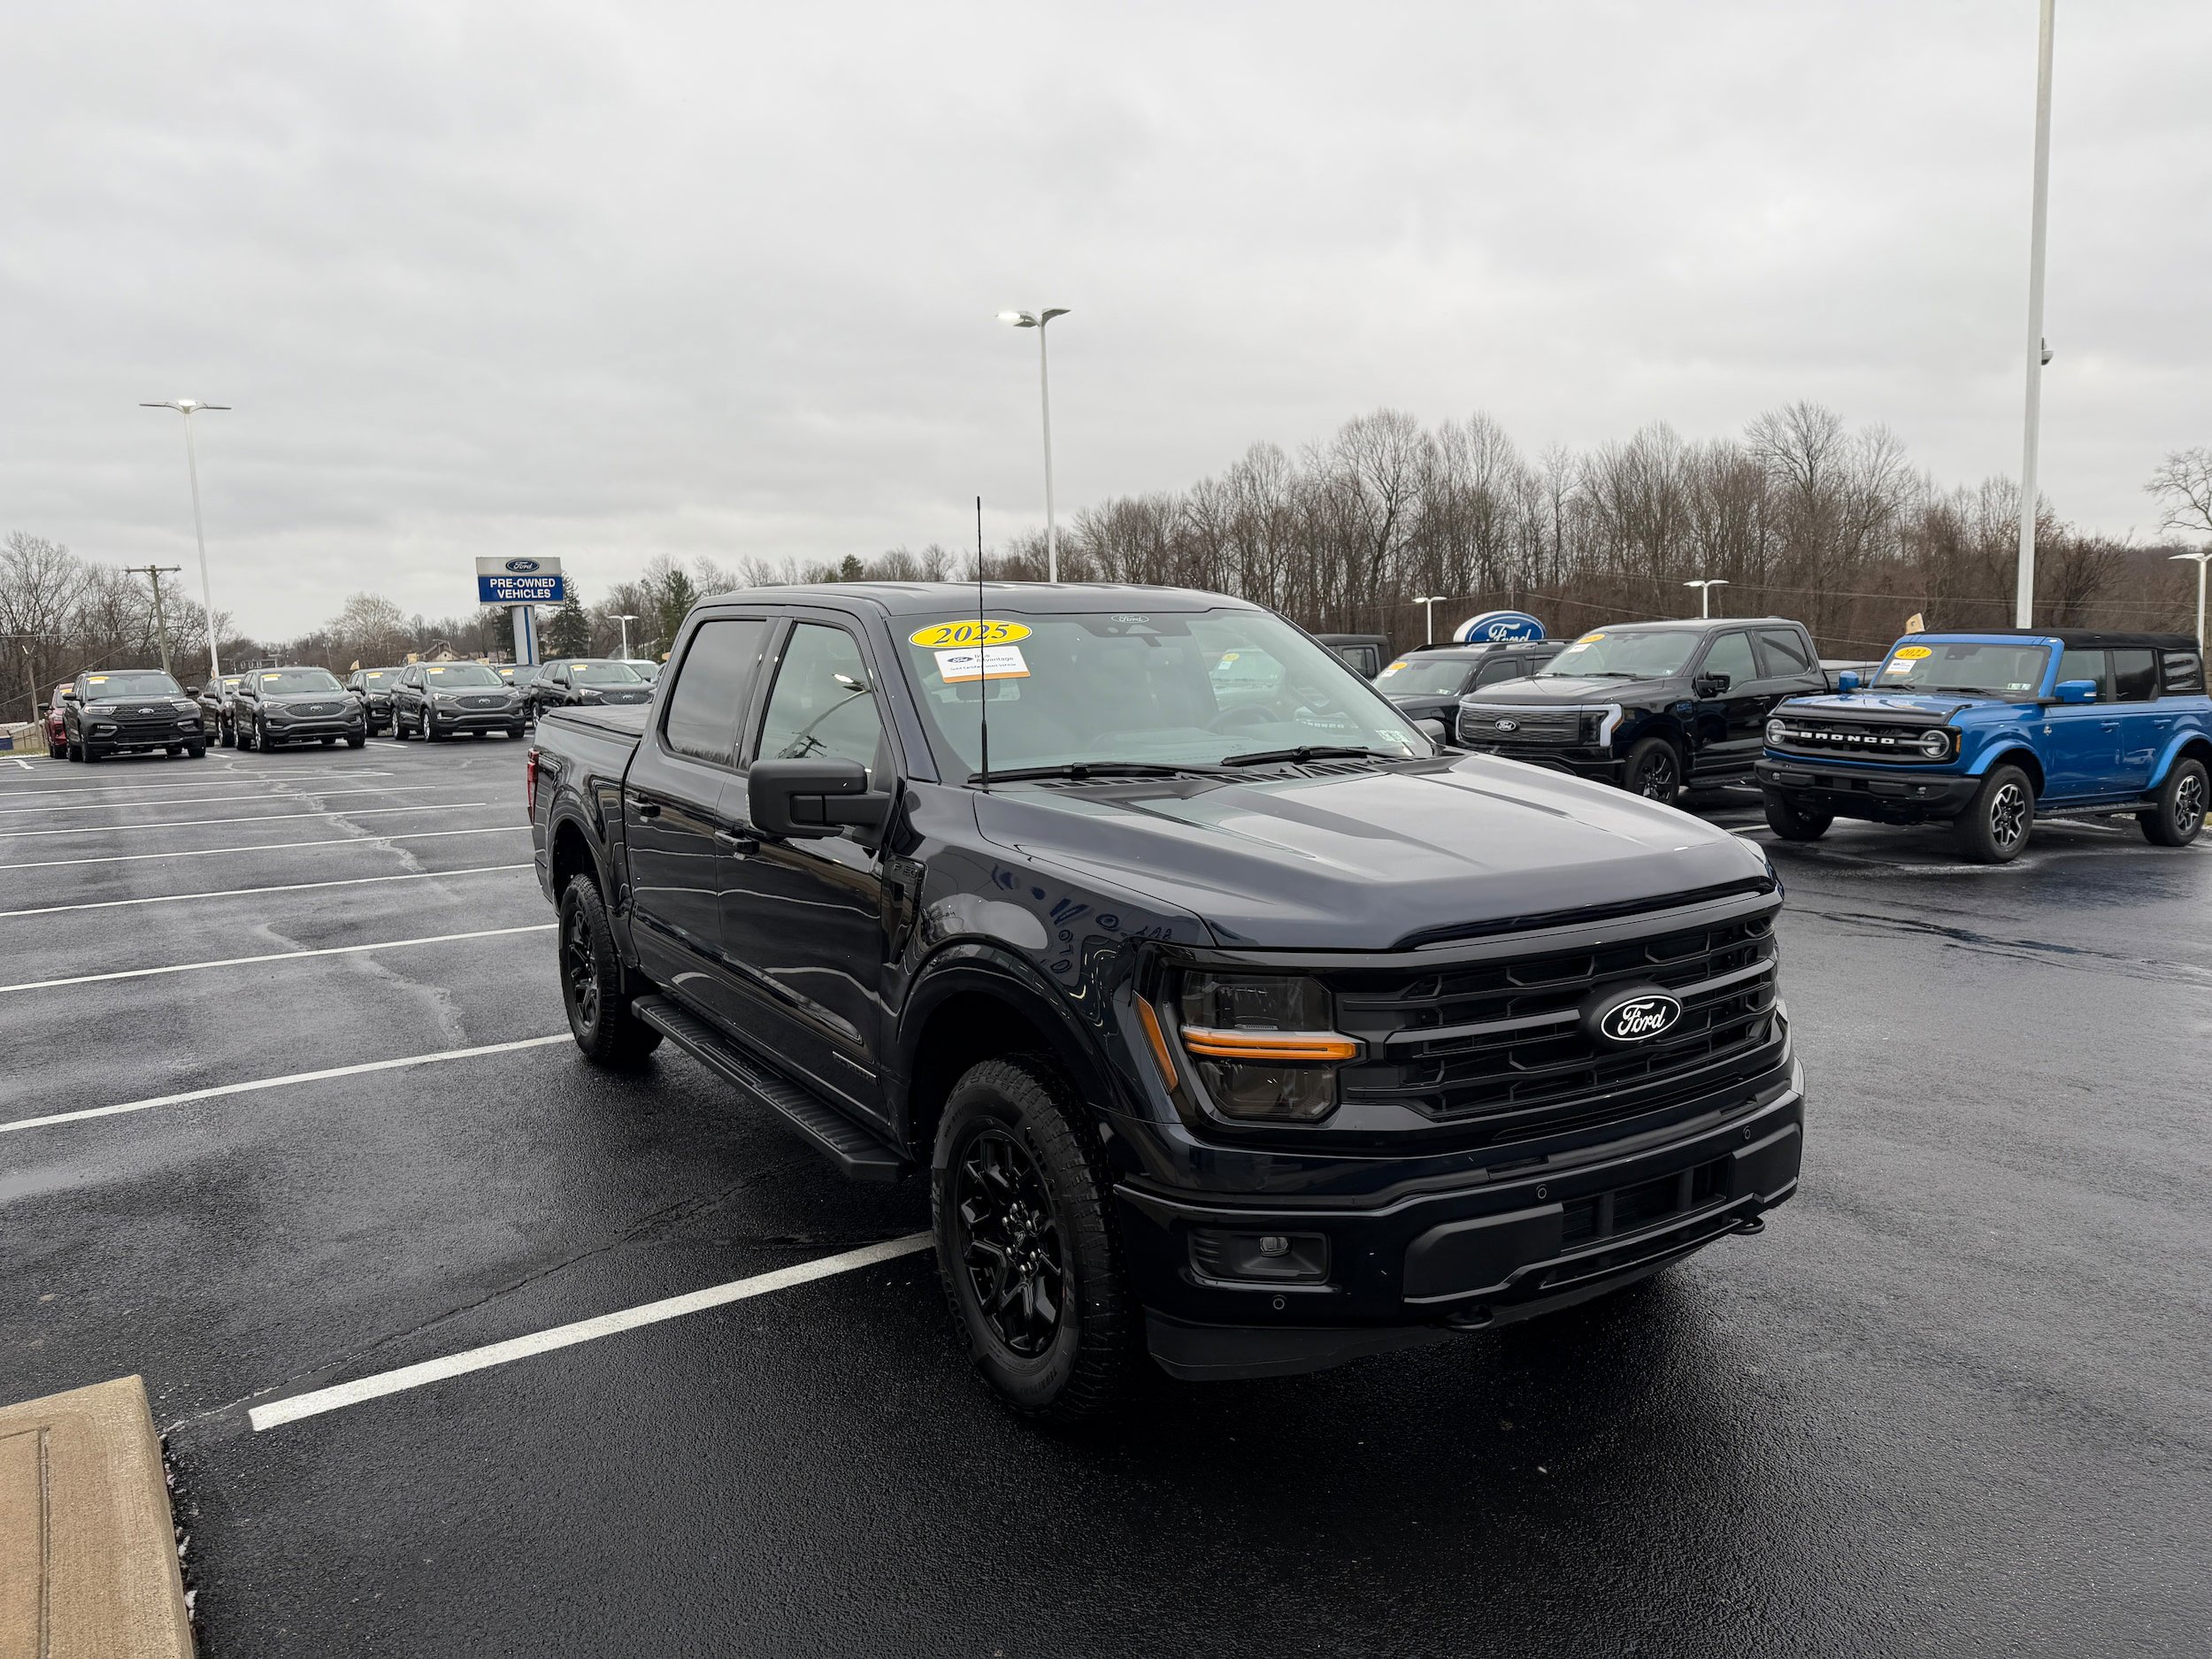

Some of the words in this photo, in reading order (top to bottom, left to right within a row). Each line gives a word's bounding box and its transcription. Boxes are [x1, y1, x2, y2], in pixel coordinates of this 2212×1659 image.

[513, 561, 534, 570] Ford
[489, 578, 556, 588] PRE-OWNED
[496, 588, 551, 599] VEHICLES
[933, 624, 1010, 644] 2025
[1800, 732, 1895, 745] BRONCO
[1617, 1002, 1667, 1036] Ford
